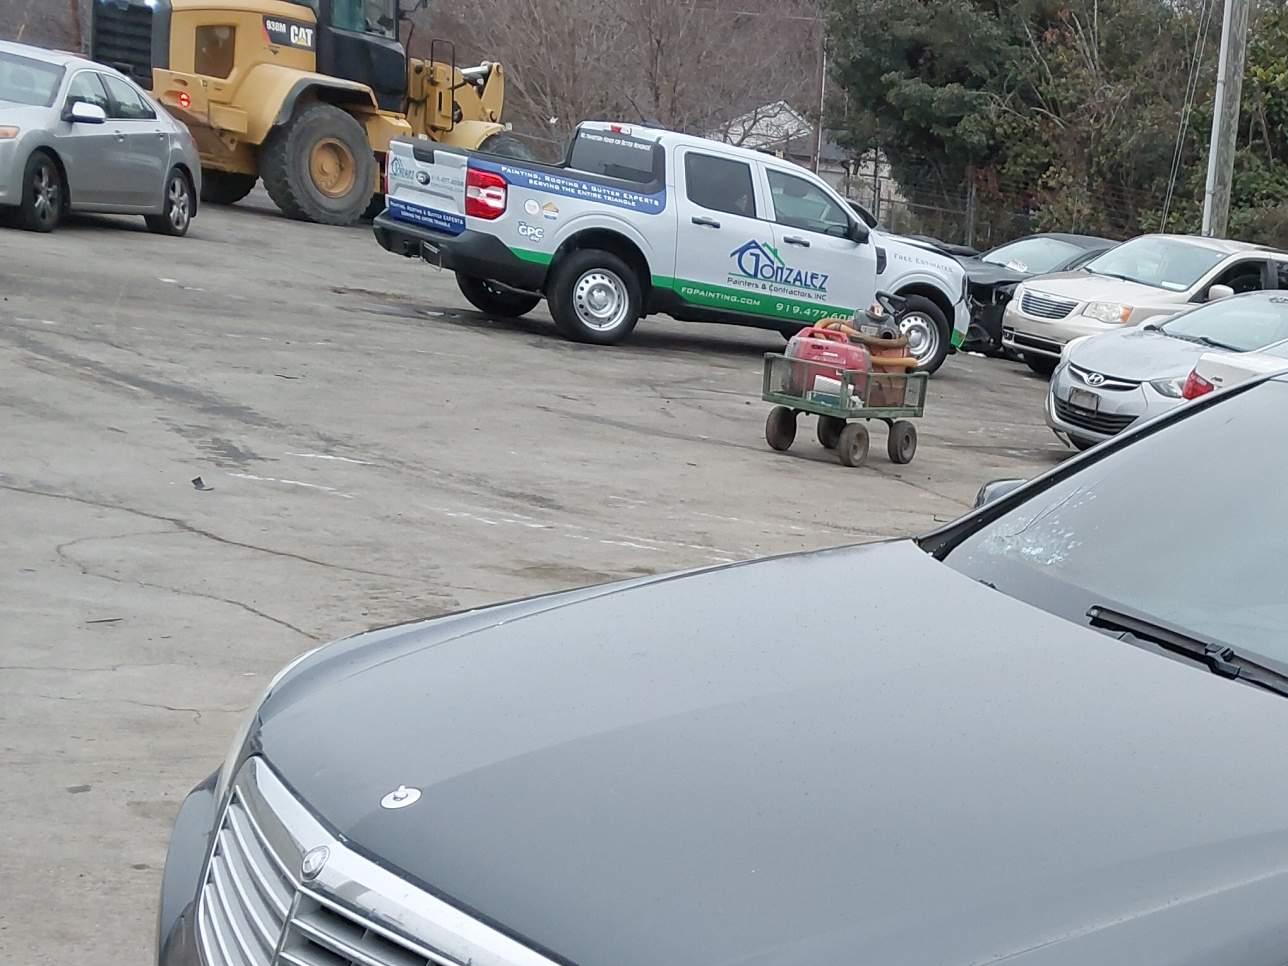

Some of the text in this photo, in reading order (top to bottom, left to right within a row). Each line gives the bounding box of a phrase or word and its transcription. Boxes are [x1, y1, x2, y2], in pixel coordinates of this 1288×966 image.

[290, 24, 313, 47] CAT
[501, 165, 541, 180] PAINTING,
[544, 175, 578, 189] ROOFING
[591, 185, 620, 197] GUTTER
[623, 192, 659, 207] EXPERTS
[528, 178, 637, 207] SERVING THE ENTIRE TRIANGLE
[518, 225, 544, 238] GPC
[727, 276, 759, 289] Painters
[761, 283, 767, 291] &
[814, 293, 827, 301] INC
